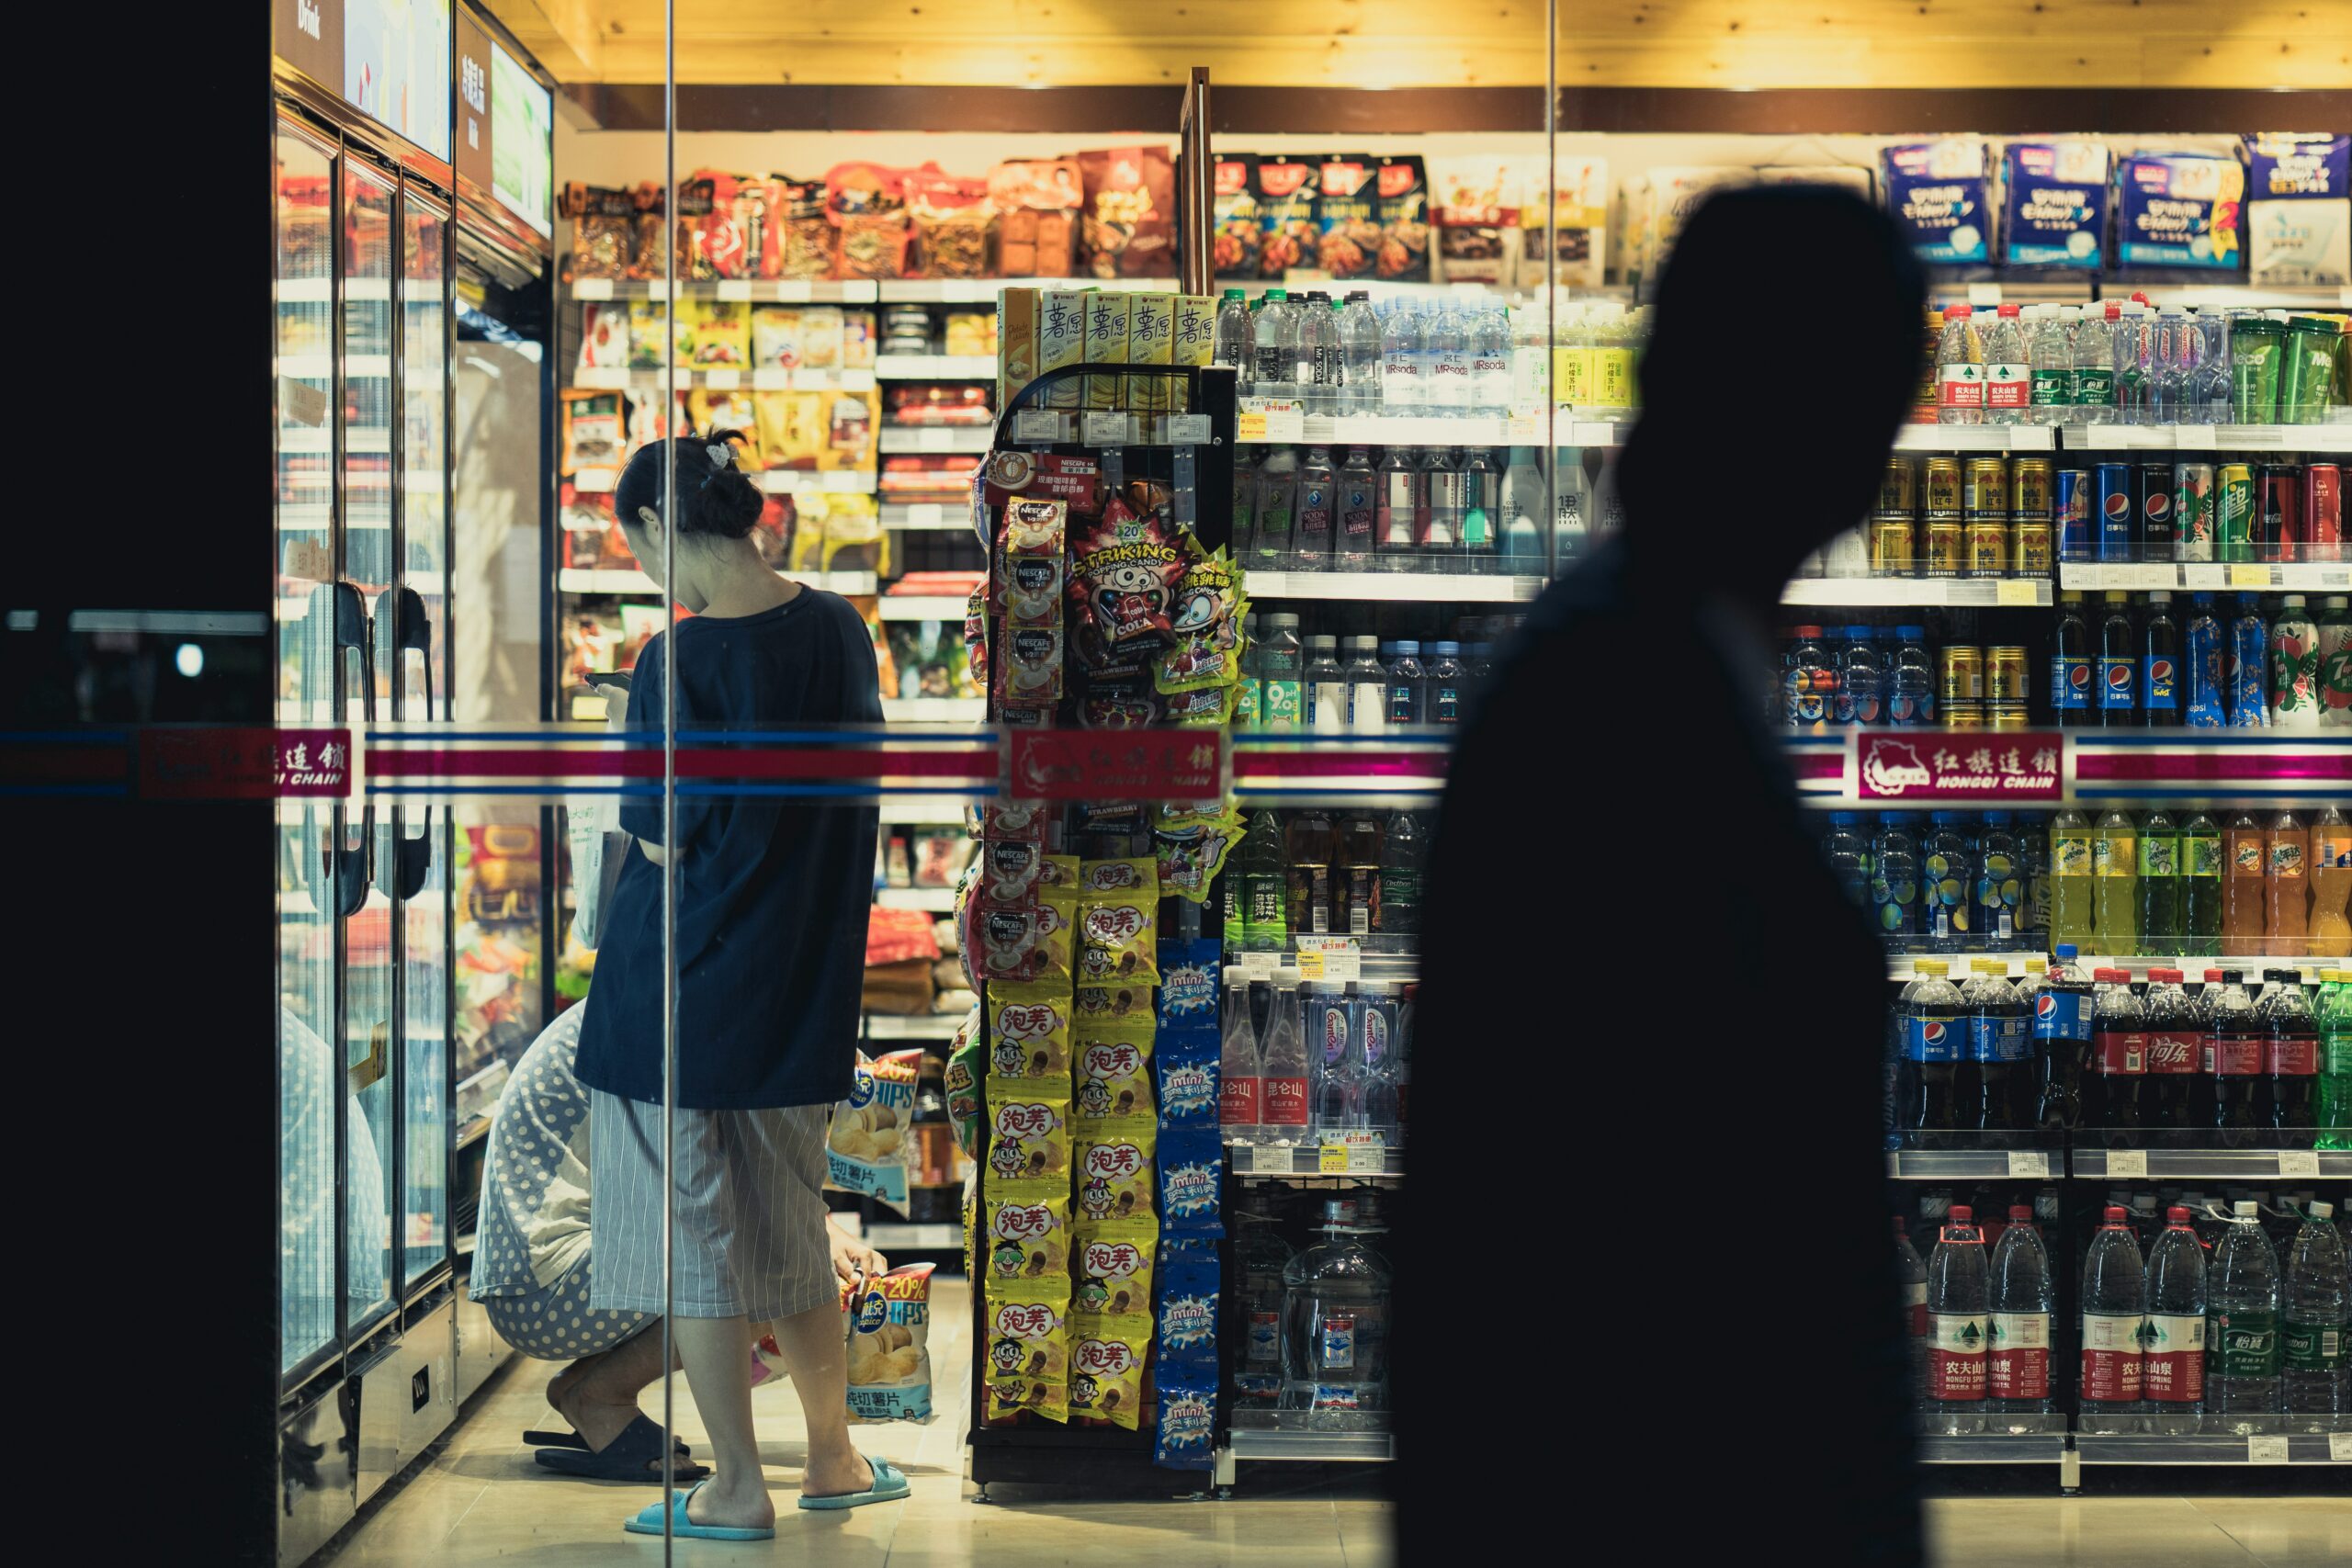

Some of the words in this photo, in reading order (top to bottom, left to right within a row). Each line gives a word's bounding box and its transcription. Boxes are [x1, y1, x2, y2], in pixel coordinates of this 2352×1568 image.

[298, 0, 321, 40] Drink
[1043, 303, 1085, 340] 薯愿
[1087, 304, 1128, 342] 薯愿
[1132, 305, 1172, 343] 薯愿
[1176, 308, 1216, 345] 薯愿
[1473, 359, 1506, 370] MRsoda
[2311, 352, 2332, 366] Me
[1435, 364, 1468, 376] MRsoda
[1304, 511, 1325, 520] SODA
[1124, 525, 1138, 537] 20
[1071, 543, 1177, 577] STRIKING
[1088, 561, 1127, 579] POPPING
[1130, 558, 1164, 568] CANDY
[1182, 570, 1230, 588] 跳跳糖
[1116, 618, 1152, 636] COLA
[1089, 664, 1140, 678] STRAWBERRY
[290, 773, 342, 785] CHAIN
[1935, 776, 1999, 789] HONGQI
[2003, 776, 2055, 789] CHAIN
[1088, 805, 1138, 816] STRAWBERRY
[997, 851, 1029, 860] NESCAFE
[1096, 865, 1134, 885] 泡芙
[1091, 909, 1136, 934] 泡芙
[1171, 975, 1204, 987] mini
[1004, 1008, 1050, 1032] 泡芙
[1090, 1047, 1135, 1072] 泡芙
[1171, 1074, 1204, 1087] mini
[1268, 1081, 1304, 1099] 昆仑山
[876, 1082, 915, 1109] HIPS
[1002, 1108, 1049, 1133] 泡芙
[1091, 1148, 1136, 1173] 泡芙
[1173, 1174, 1205, 1189] mini
[1001, 1209, 1047, 1235] 泡芙
[1088, 1247, 1135, 1272] 泡芙
[888, 1277, 925, 1301] 20%
[888, 1302, 926, 1326] HIPS
[1002, 1308, 1049, 1333] 泡芙
[1170, 1306, 1204, 1320] mini
[1080, 1346, 1127, 1370] 泡芙
[1991, 1359, 2011, 1373] 山泉
[2122, 1361, 2142, 1376] 农夫
[1171, 1404, 1203, 1419] mini
